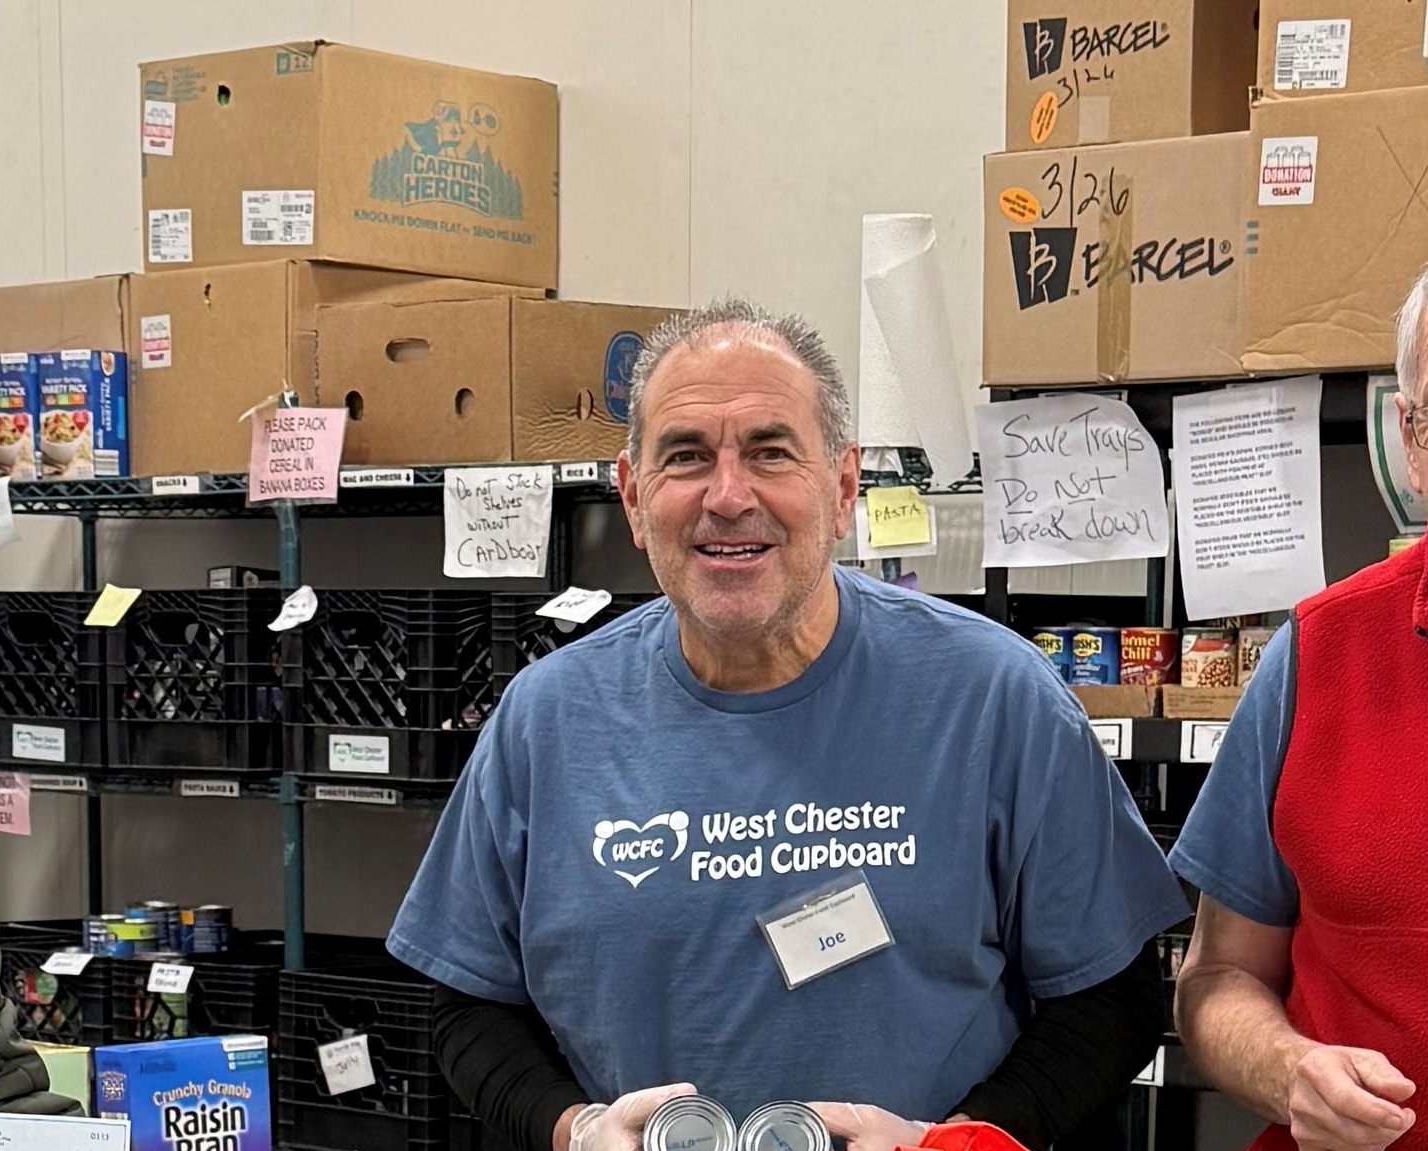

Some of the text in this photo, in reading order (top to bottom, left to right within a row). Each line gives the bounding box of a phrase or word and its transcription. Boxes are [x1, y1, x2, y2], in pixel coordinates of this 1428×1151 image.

[413, 155, 483, 183] CARTON
[404, 175, 490, 216] HEROES
[1042, 156, 1129, 227] 3/26
[265, 417, 327, 432] PLEASE PACK
[271, 437, 314, 453] DONATED
[1003, 415, 1072, 458] Save
[1069, 407, 1144, 471] Trays
[269, 458, 314, 473] CEREAL IN
[260, 477, 325, 494] BANANA BOXES
[995, 467, 1116, 508] Do Not
[1085, 507, 1155, 541] down
[1122, 647, 1151, 660] Chili
[702, 801, 905, 844] West Chester
[612, 838, 664, 862] WCFC
[691, 835, 916, 881] Food Cupboard
[819, 930, 846, 952] Joe
[153, 1079, 251, 1106] Crunchy Granola
[165, 1100, 246, 1138] Raisin
